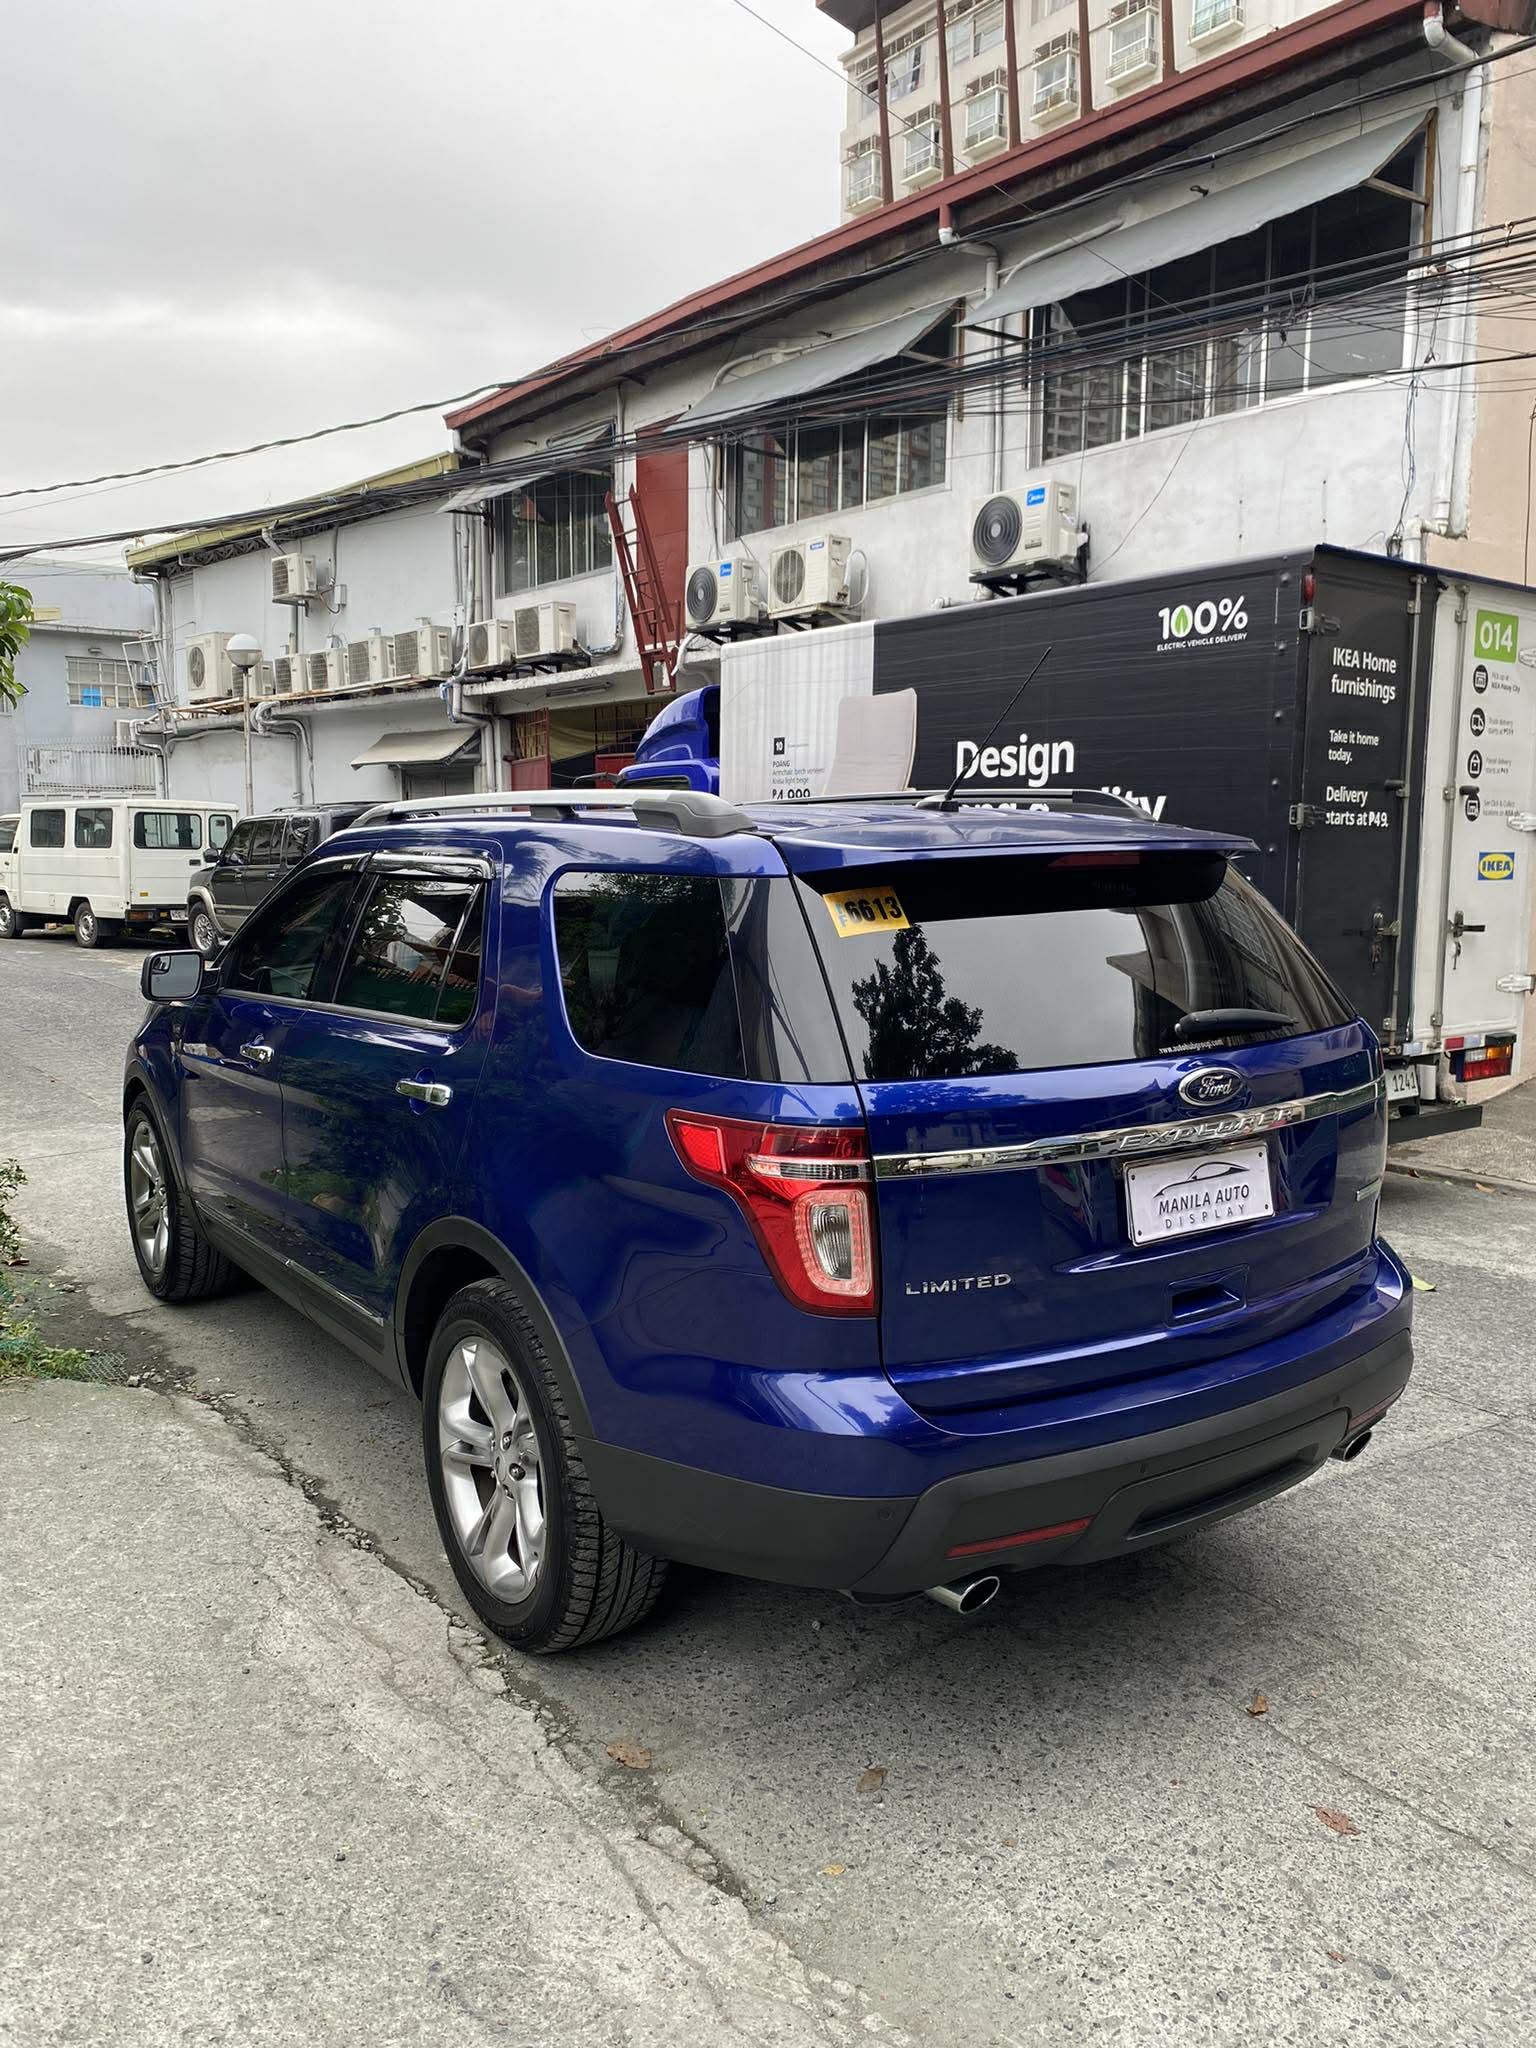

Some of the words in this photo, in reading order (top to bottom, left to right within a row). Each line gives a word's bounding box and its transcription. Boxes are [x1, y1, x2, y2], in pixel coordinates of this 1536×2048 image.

[1158, 595, 1248, 640] 100%
[1156, 641, 1186, 652] ELECTRIC
[1187, 637, 1214, 648] VEHICLE
[1215, 633, 1247, 643] DELIVERY
[1480, 620, 1513, 653] 014
[1333, 647, 1360, 669] IKEA
[1362, 651, 1397, 673] Home
[1331, 673, 1396, 704] furnishings
[1329, 729, 1348, 743] Take
[1349, 731, 1356, 744] it
[1356, 732, 1379, 746] home
[957, 733, 1074, 787] Design
[1328, 748, 1353, 765] today.
[1326, 786, 1368, 807] Delivery
[1325, 810, 1355, 825] starts
[1356, 812, 1368, 826] at
[1481, 860, 1511, 872] IKEA
[844, 896, 902, 924] 6613
[1199, 1075, 1233, 1098] Ford
[1393, 1072, 1416, 1092] 1241
[1119, 1108, 1294, 1149] EXPLORER
[1159, 1192, 1211, 1216] MANILA
[1215, 1184, 1250, 1203] AUTO
[1165, 1204, 1246, 1229] DISPLAY
[905, 1273, 1012, 1295] LIMITED
